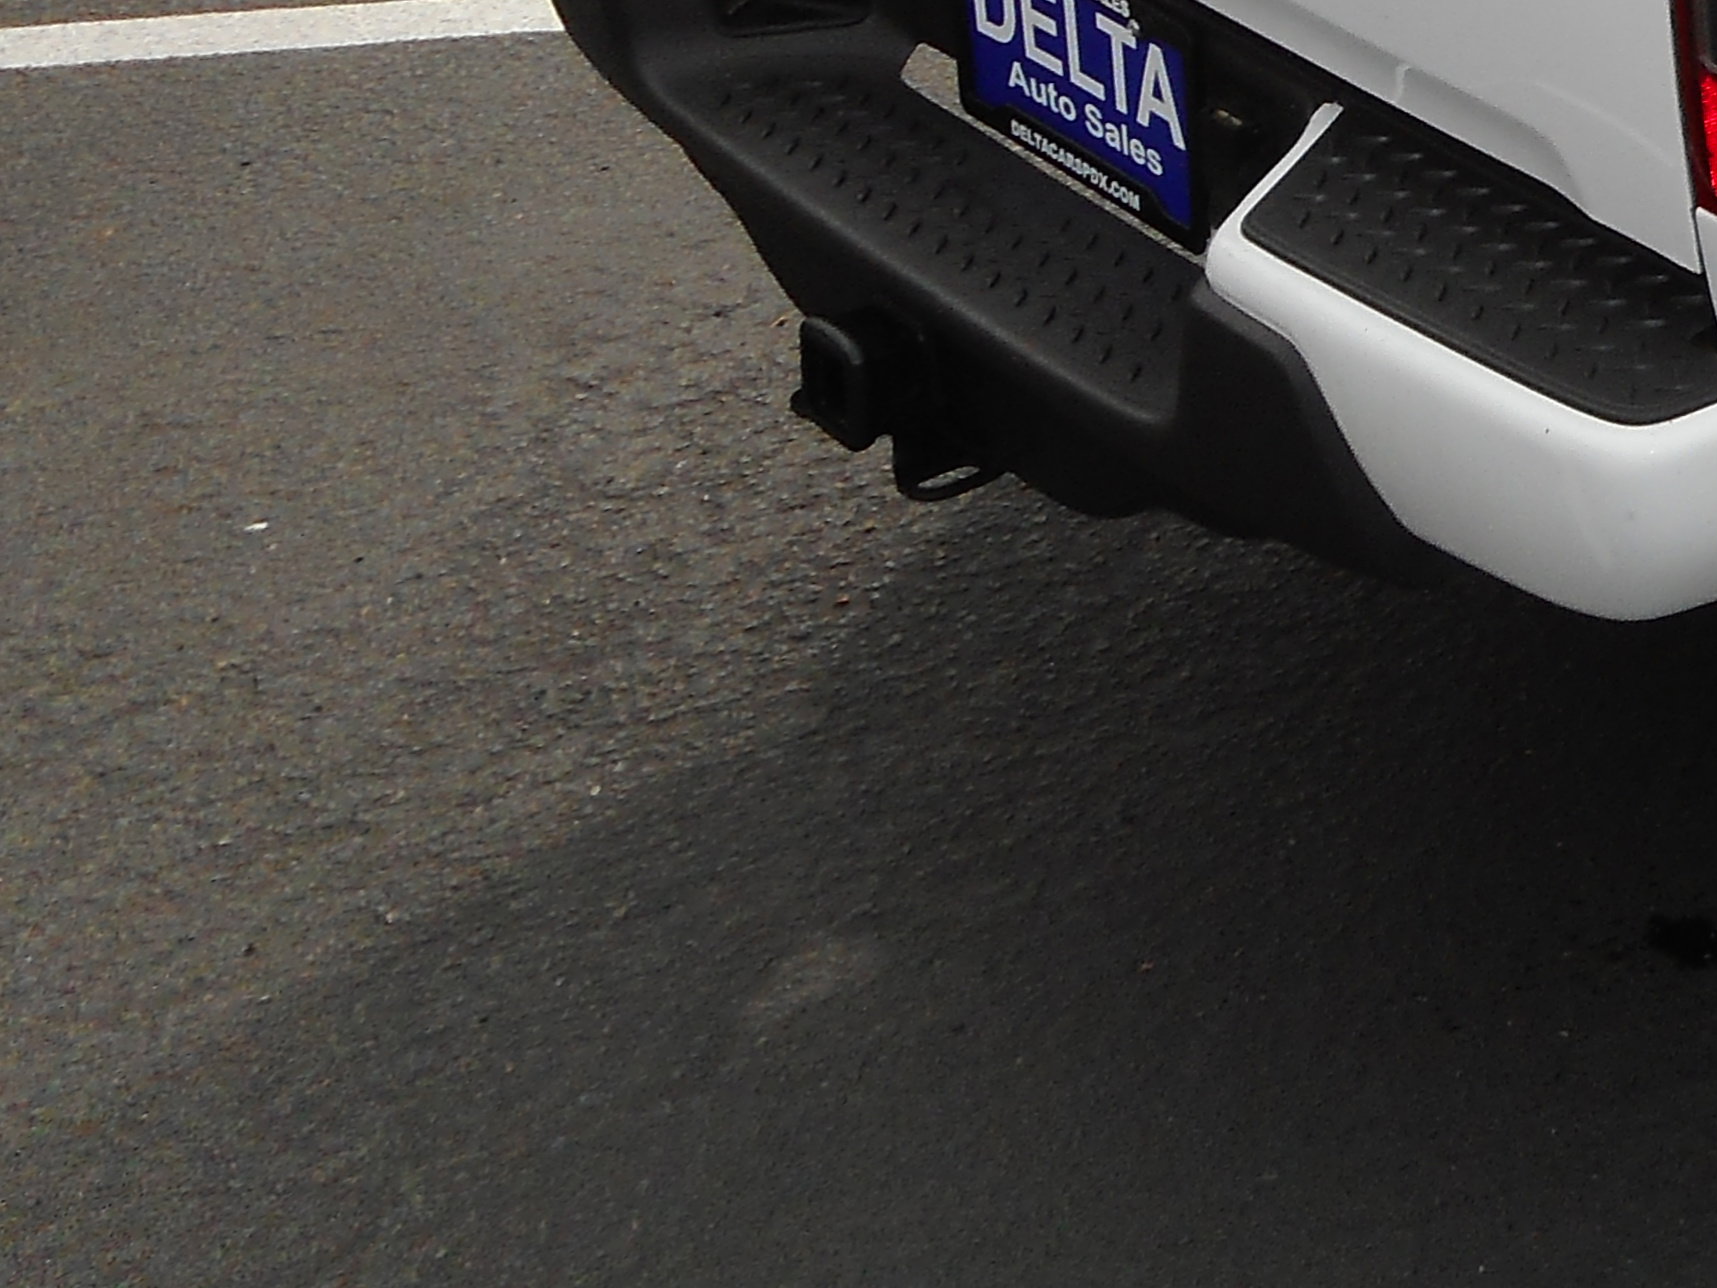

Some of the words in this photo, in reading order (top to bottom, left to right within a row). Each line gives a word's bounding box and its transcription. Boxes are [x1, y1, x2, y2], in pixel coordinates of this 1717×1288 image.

[1009, 61, 1076, 121] Auto
[1085, 103, 1164, 176] Sales
[1010, 118, 1141, 211] DELTACARSPDX.COM
